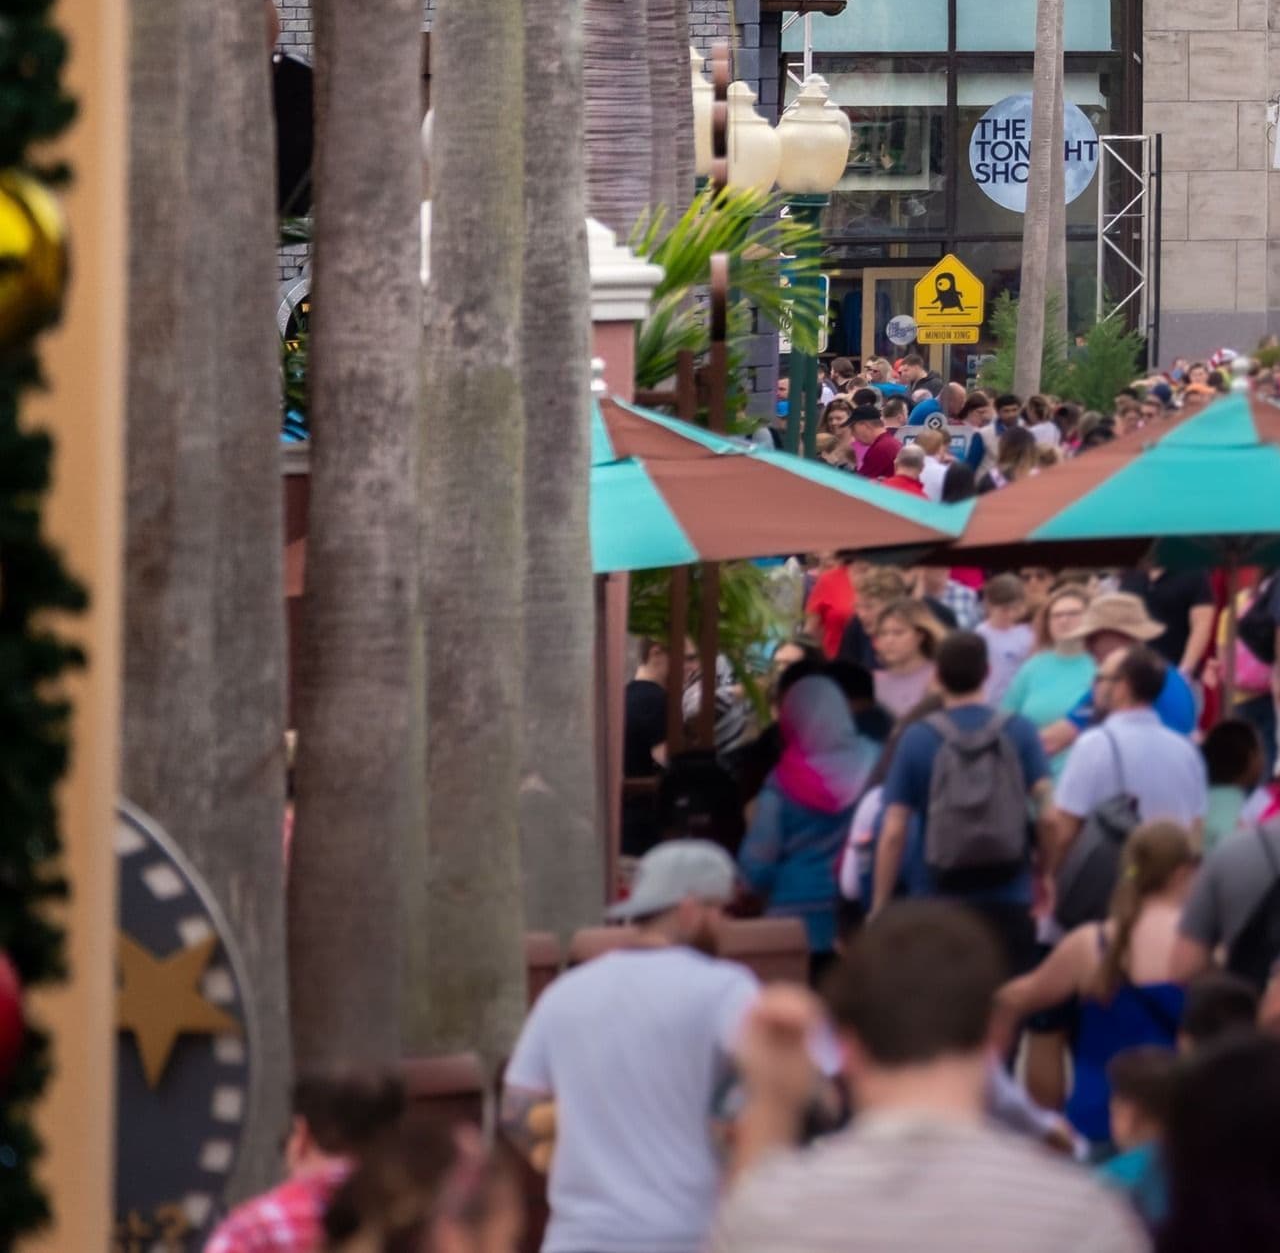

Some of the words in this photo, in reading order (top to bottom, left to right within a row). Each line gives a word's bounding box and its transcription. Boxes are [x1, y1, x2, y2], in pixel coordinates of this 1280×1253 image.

[978, 118, 1026, 140] THE
[975, 140, 1098, 162] TONHT
[975, 162, 1030, 184] SHO
[925, 330, 951, 340] MINION
[954, 330, 971, 339] XING
